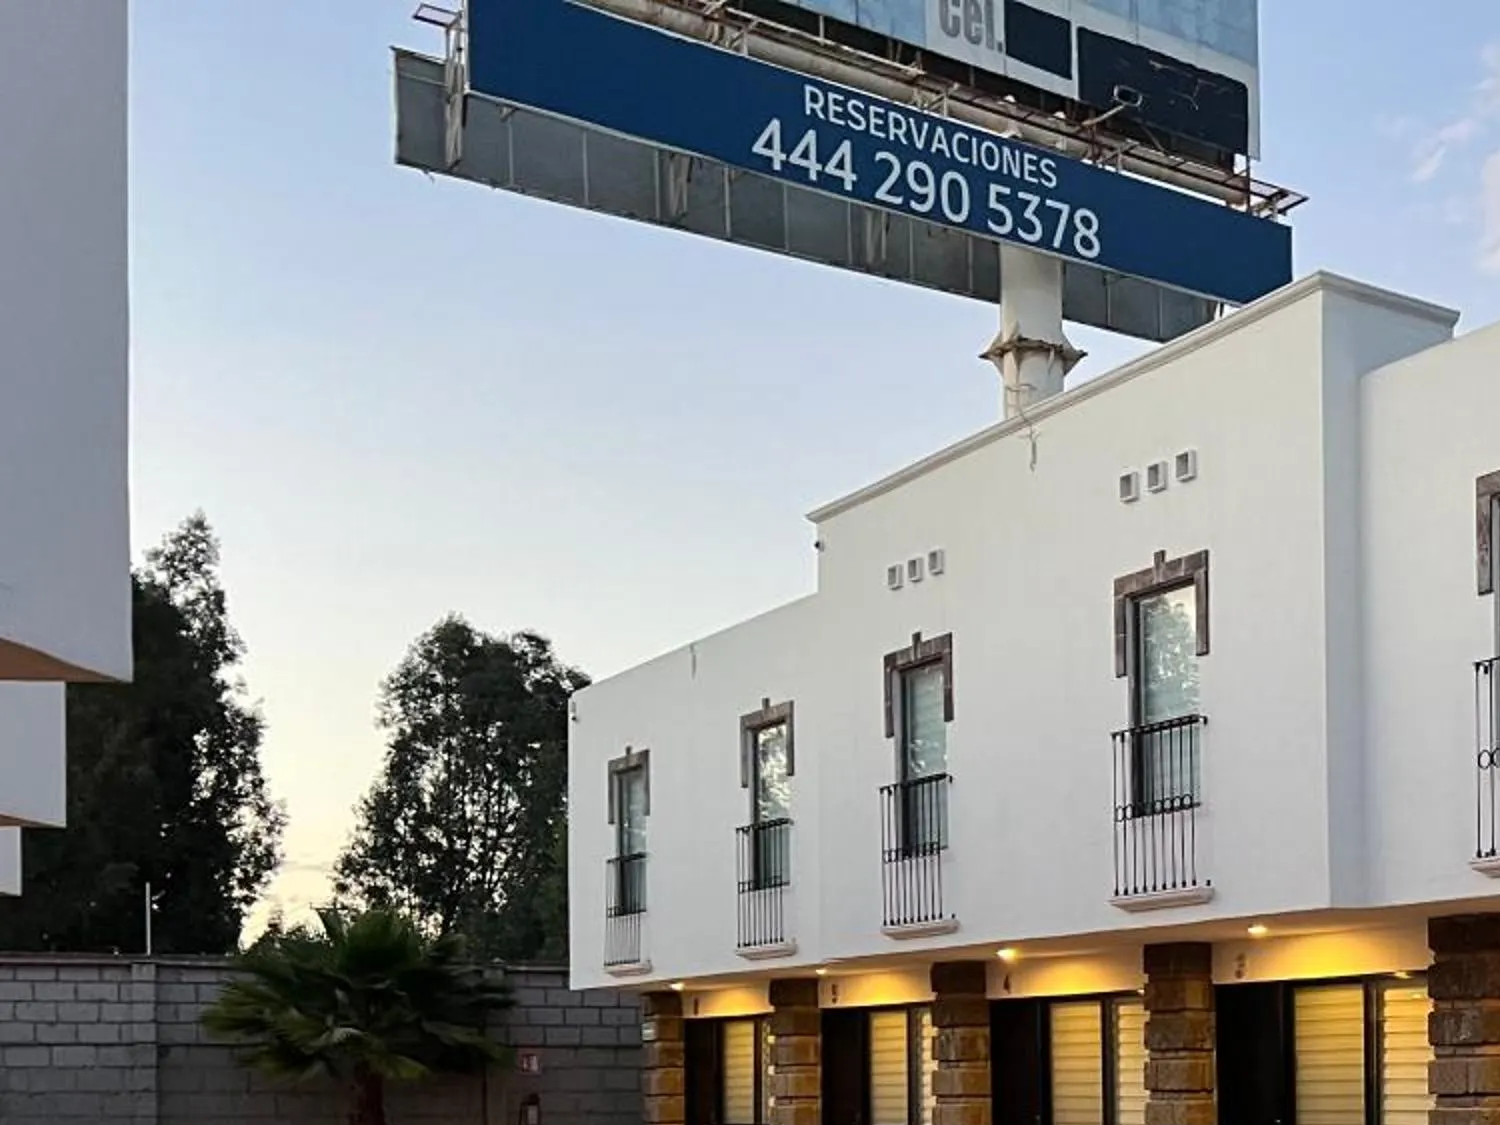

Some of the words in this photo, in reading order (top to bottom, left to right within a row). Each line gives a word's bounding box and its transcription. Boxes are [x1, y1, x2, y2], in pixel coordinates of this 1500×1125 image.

[751, 117, 857, 192] 444
[874, 151, 970, 225] 290
[987, 182, 1102, 260] 5378
[804, 84, 1058, 189] RESERVACIONES
